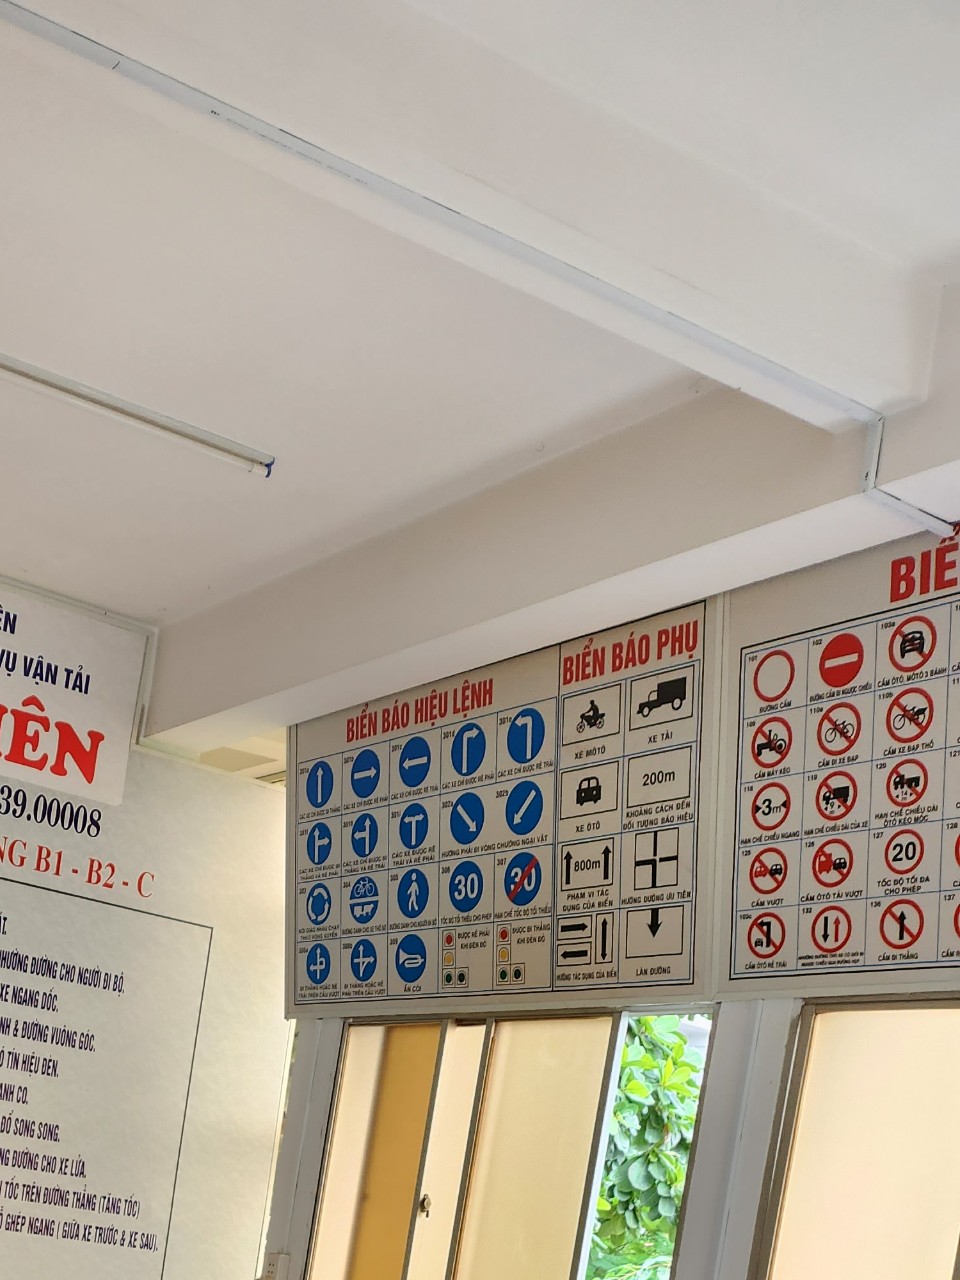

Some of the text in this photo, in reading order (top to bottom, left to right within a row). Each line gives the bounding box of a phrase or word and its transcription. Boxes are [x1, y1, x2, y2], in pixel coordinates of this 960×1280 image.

[561, 620, 698, 685] BIỂN BÁO PHỤ
[23, 654, 59, 686] VẬN
[63, 665, 91, 695] TẢI
[346, 679, 493, 741] BIỂN BÁO HIỆU LỆNH
[642, 770, 675, 786] 200m
[573, 858, 600, 872] 800m
[891, 841, 916, 862] 20
[34, 844, 64, 878] B1
[85, 857, 117, 891] B2
[136, 871, 155, 897] C
[454, 873, 478, 899] 30
[29, 954, 59, 980] ĐƯỜNG
[58, 962, 77, 984] CHO
[76, 965, 103, 989] NGƯỜI
[101, 971, 112, 991] ĐI
[111, 971, 125, 998] BỘ.
[10, 985, 40, 1009] NGANG
[40, 987, 59, 1013] DỐC.
[12, 1019, 20, 1038] &
[20, 1018, 50, 1044] ĐƯỜNG
[50, 1024, 78, 1049] VUÔNG
[78, 1029, 96, 1053] GÓC.
[6, 1047, 21, 1071] TÍN
[20, 1051, 41, 1078] HIỆU
[40, 1054, 59, 1078] ĐÈN.
[15, 1085, 29, 1106] CO.
[12, 1117, 36, 1139] SONG
[36, 1121, 60, 1143] SONG.
[11, 1147, 40, 1172] ĐƯỜNG
[40, 1154, 58, 1174] CHO
[57, 1156, 70, 1176] XE
[3, 1175, 20, 1201] TỐC
[21, 1180, 43, 1204] TRÊN
[42, 1184, 70, 1208] ĐƯỜNG
[4, 1210, 27, 1234] GHÉP
[26, 1216, 56, 1238] NGANG
[80, 1223, 93, 1243] XE
[93, 1223, 119, 1246] TRƯỚC
[119, 1229, 126, 1247] &
[126, 1230, 139, 1249] XE
